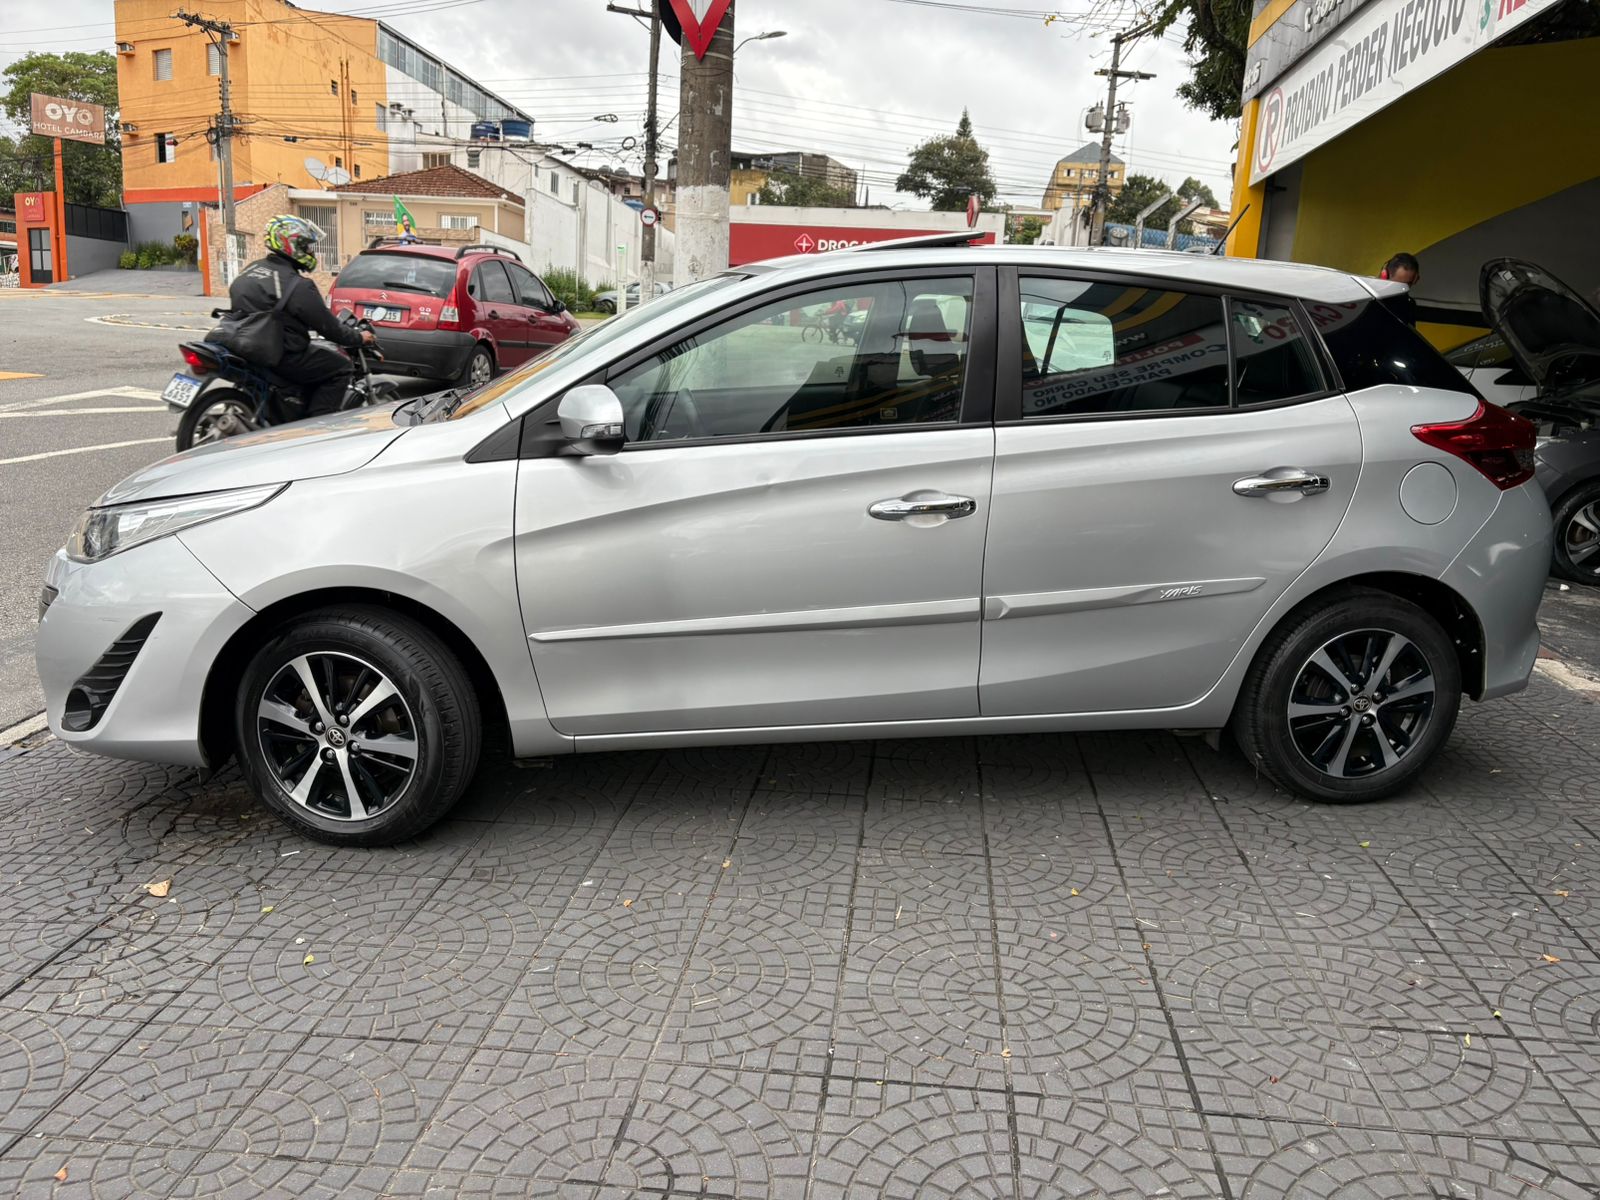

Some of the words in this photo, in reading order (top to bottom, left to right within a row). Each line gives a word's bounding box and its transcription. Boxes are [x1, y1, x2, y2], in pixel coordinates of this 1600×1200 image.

[1281, 63, 1334, 148] PROIBIDO
[1333, 21, 1388, 114] PERDER
[45, 103, 94, 126] OYO
[33, 121, 62, 133] HOTEL
[1160, 585, 1203, 599] YARIS
